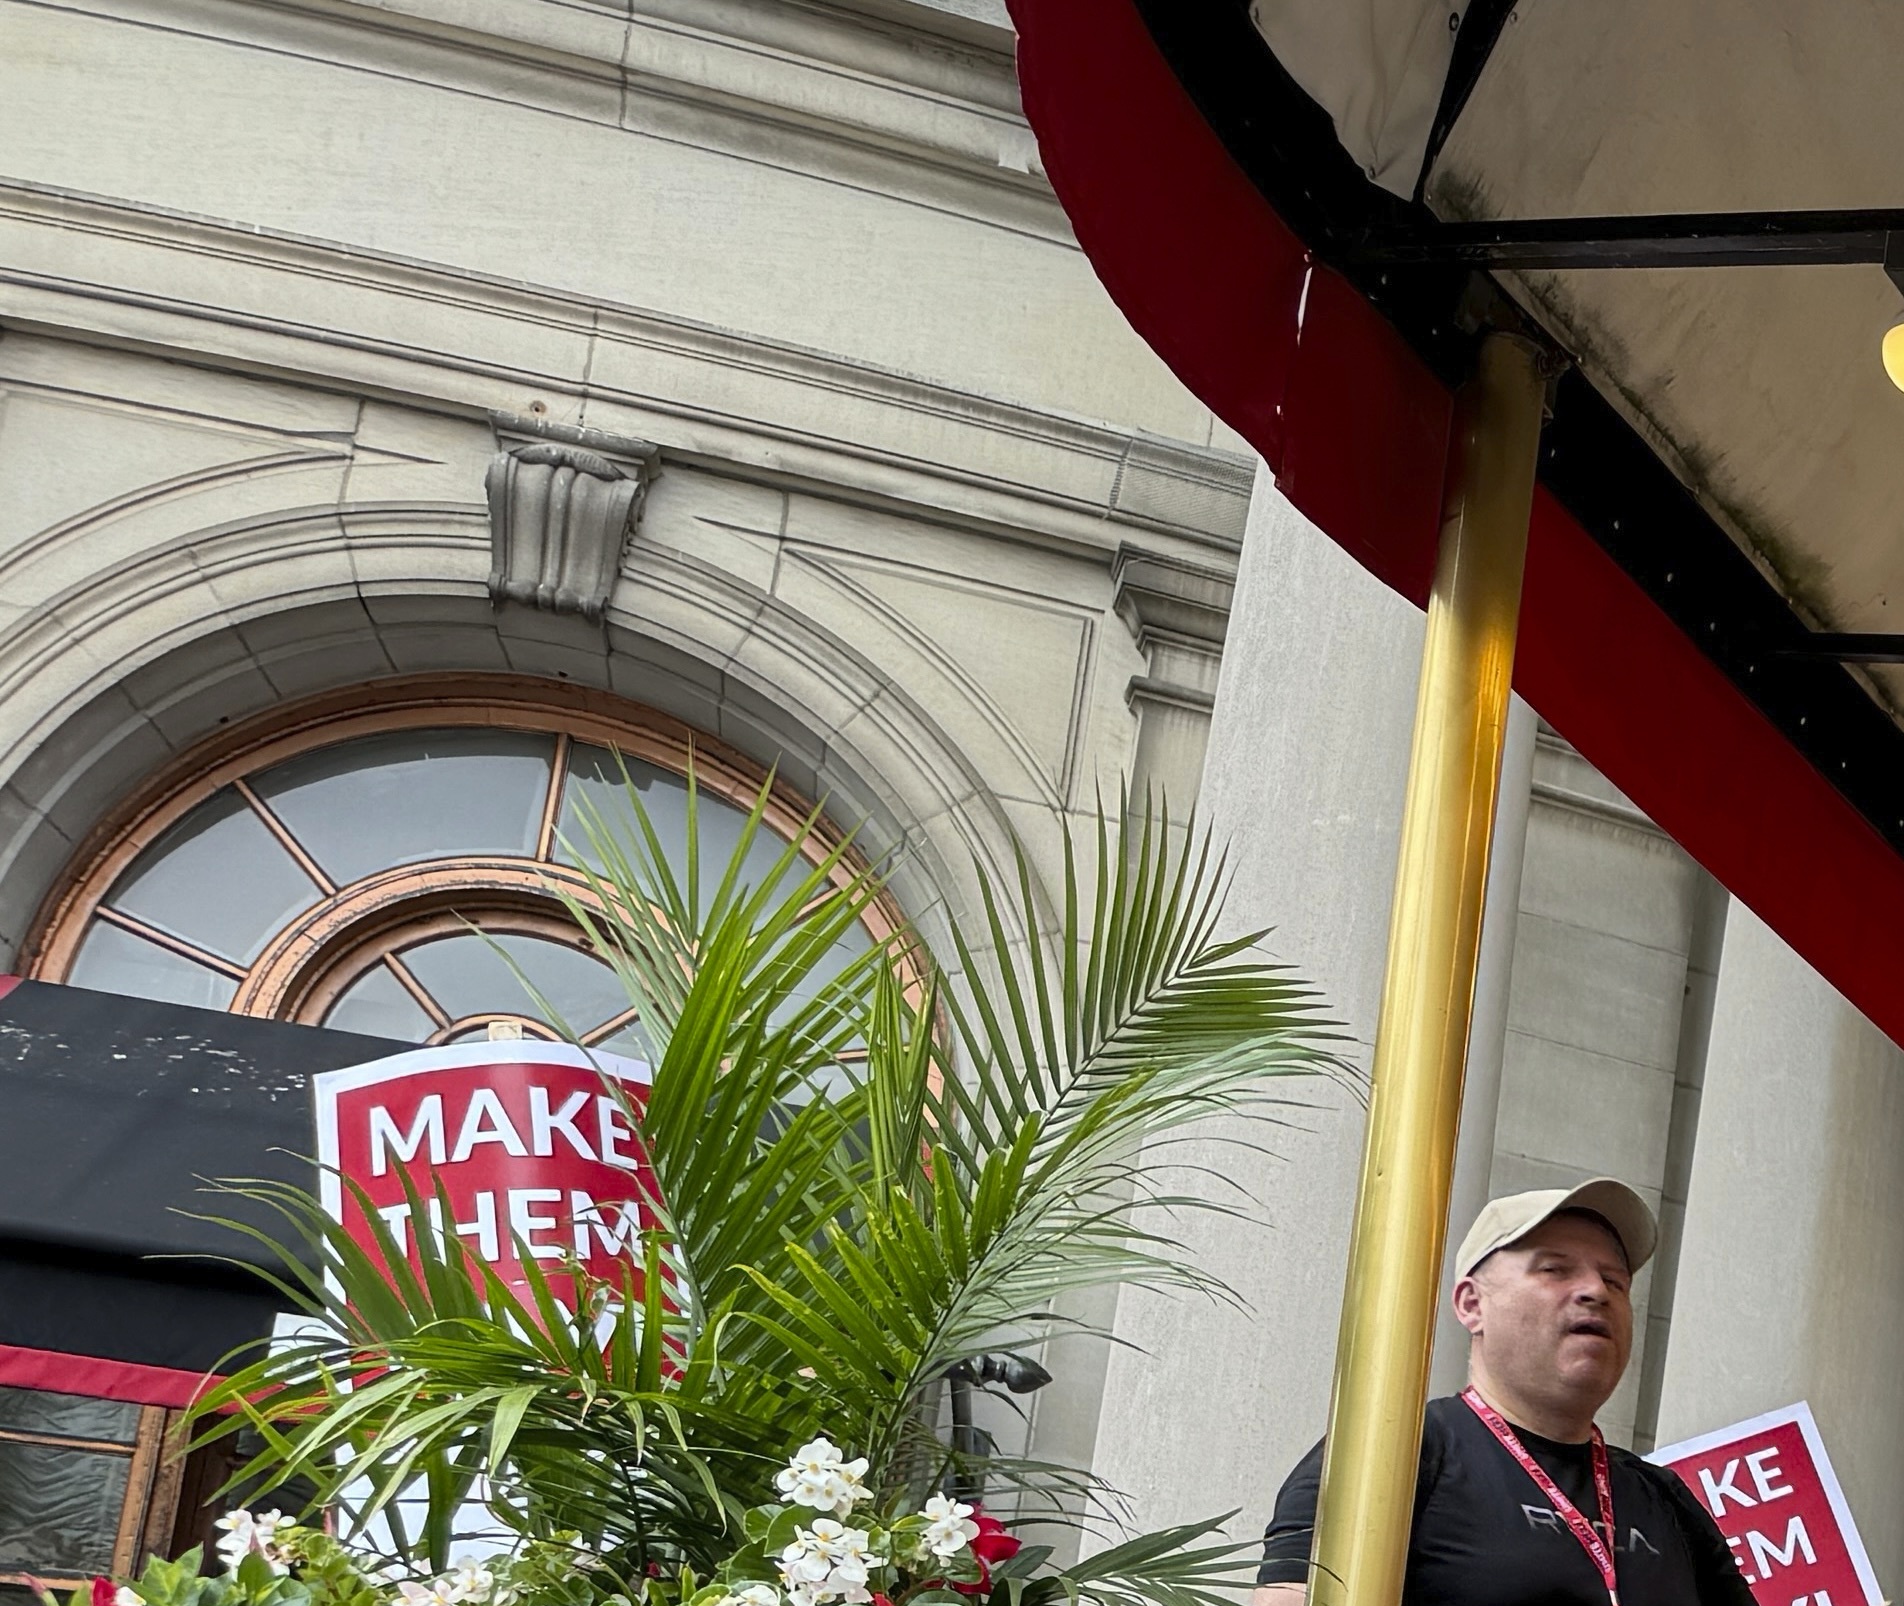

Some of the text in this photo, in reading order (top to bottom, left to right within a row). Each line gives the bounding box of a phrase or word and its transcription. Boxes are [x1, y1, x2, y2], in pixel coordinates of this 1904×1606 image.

[370, 1086, 638, 1177] MAKE
[377, 1189, 646, 1266] THEM
[1697, 1446, 1795, 1518] KE
